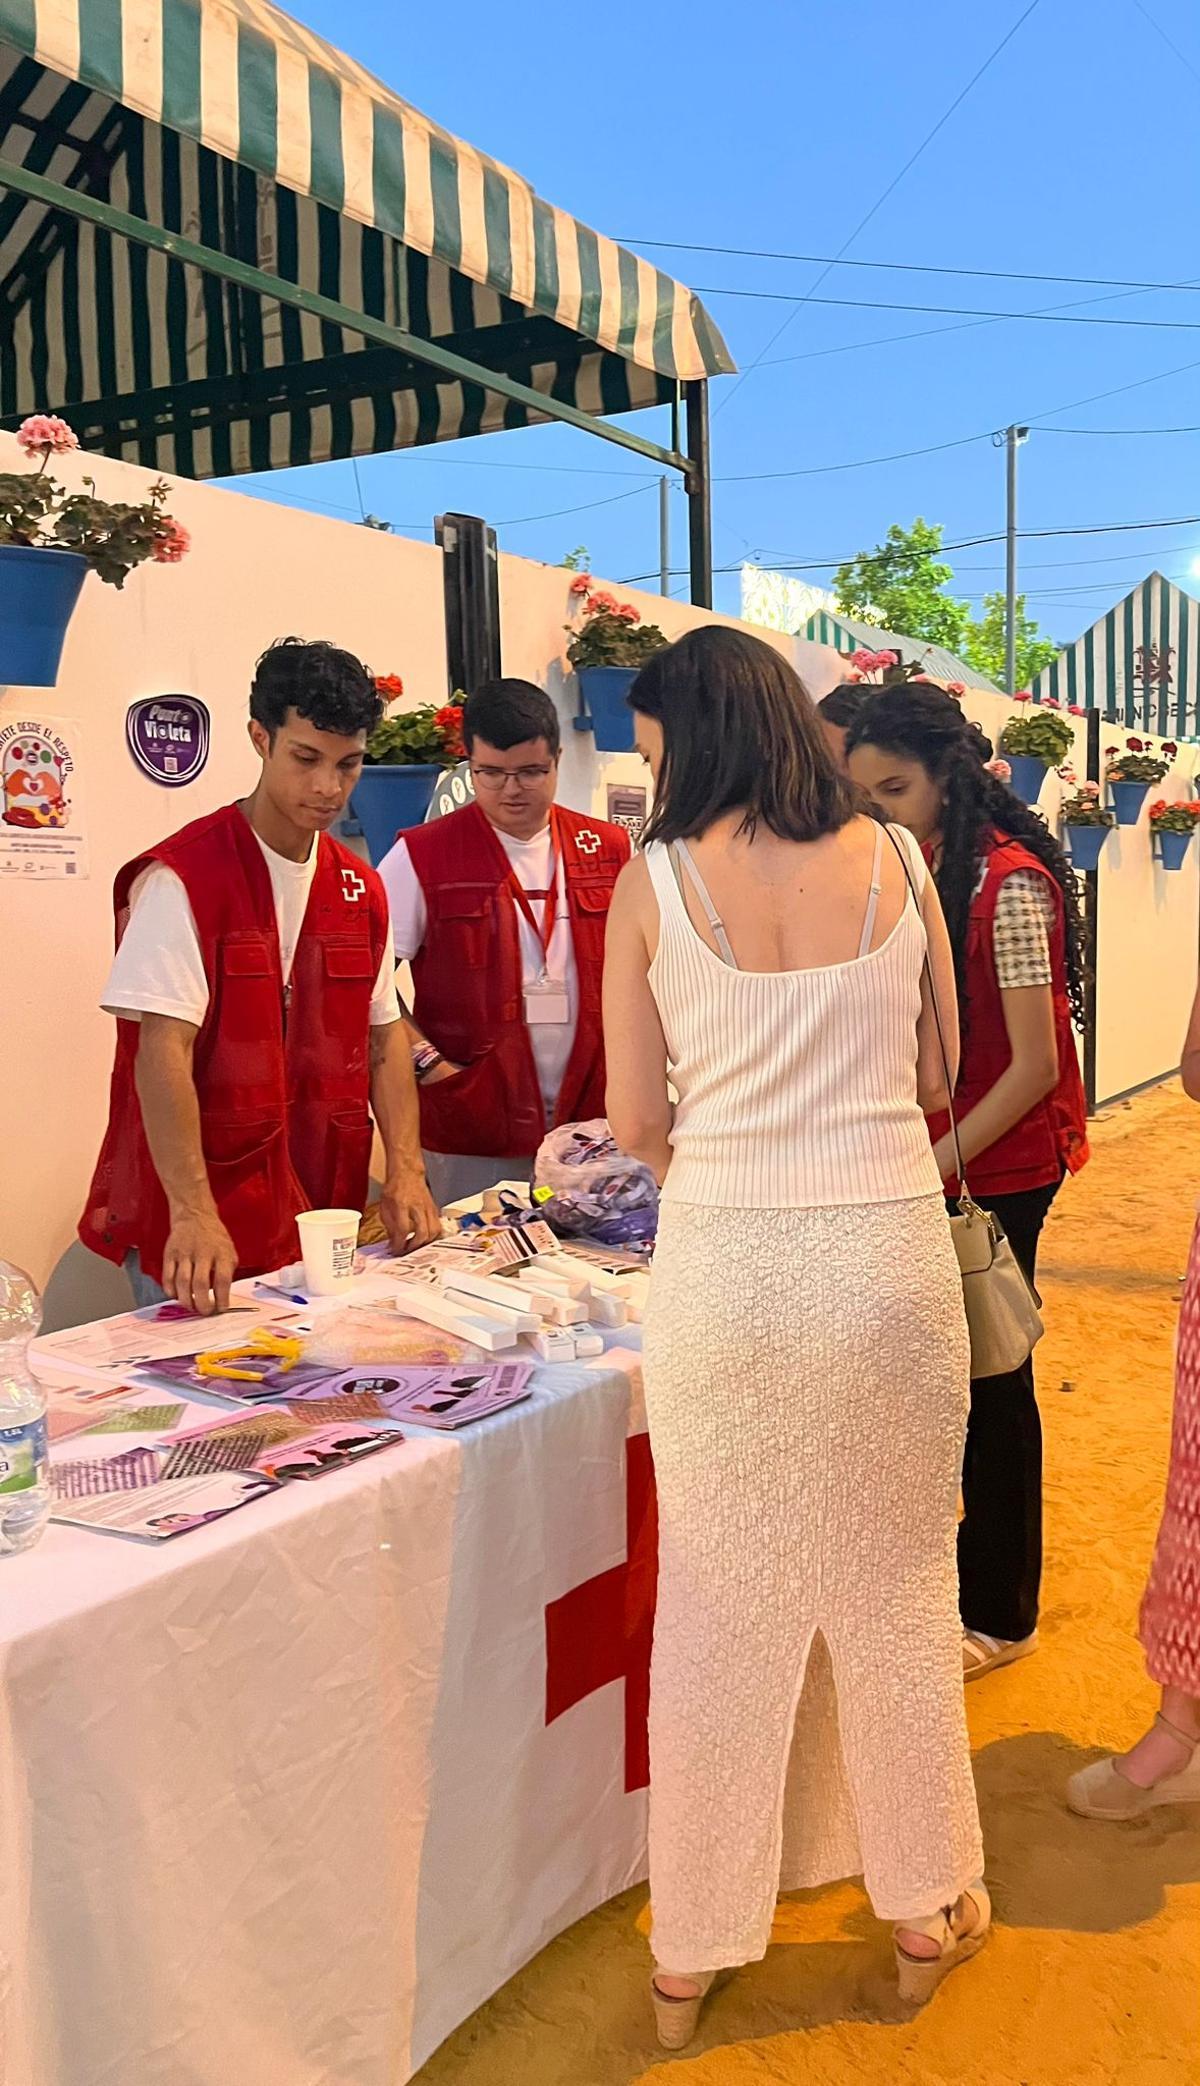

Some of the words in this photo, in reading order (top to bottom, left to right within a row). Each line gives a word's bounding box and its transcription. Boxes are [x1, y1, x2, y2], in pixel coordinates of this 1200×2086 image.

[148, 704, 193, 723] Punto
[144, 720, 191, 742] Violeta
[43, 727, 52, 740] EL
[53, 736, 74, 772] RESPETO
